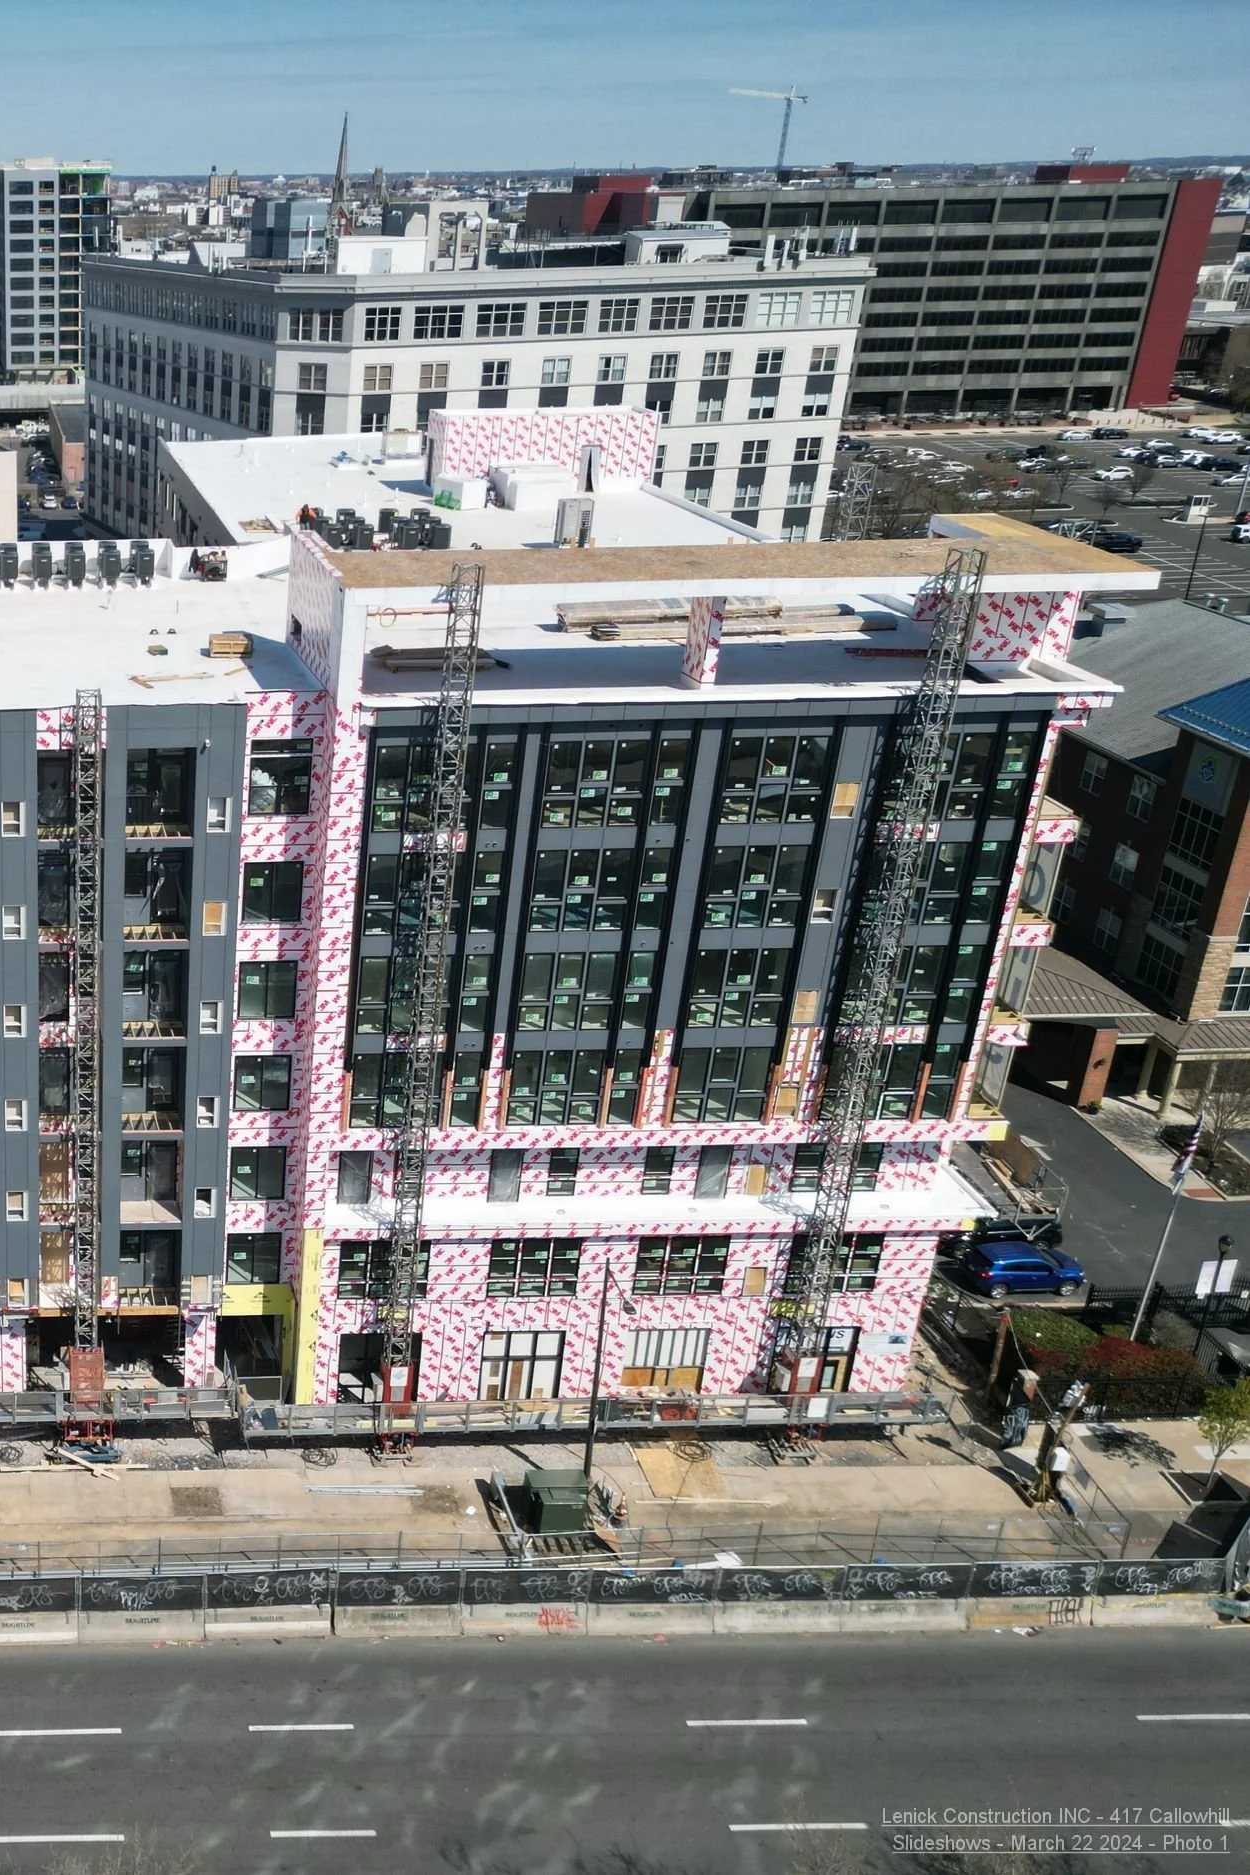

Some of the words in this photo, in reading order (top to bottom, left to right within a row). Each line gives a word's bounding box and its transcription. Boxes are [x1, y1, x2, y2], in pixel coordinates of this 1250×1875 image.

[988, 600, 1001, 613] 3M
[1014, 594, 1027, 607] 3M
[1029, 595, 1043, 608] 3M
[1002, 607, 1015, 620] 3M
[1051, 601, 1064, 614] 3M
[977, 612, 990, 625] 3M
[1035, 609, 1048, 621] 3M
[1058, 615, 1071, 628] 3M
[982, 625, 995, 638] 3M
[1008, 620, 1021, 633] 3M
[1023, 621, 1037, 634] 3M
[1046, 627, 1059, 640] 3M
[971, 638, 984, 651] 3M
[998, 638, 1011, 651] 3M
[1029, 634, 1042, 647] 3M
[1052, 641, 1065, 653] 3M
[982, 647, 995, 659] 3M
